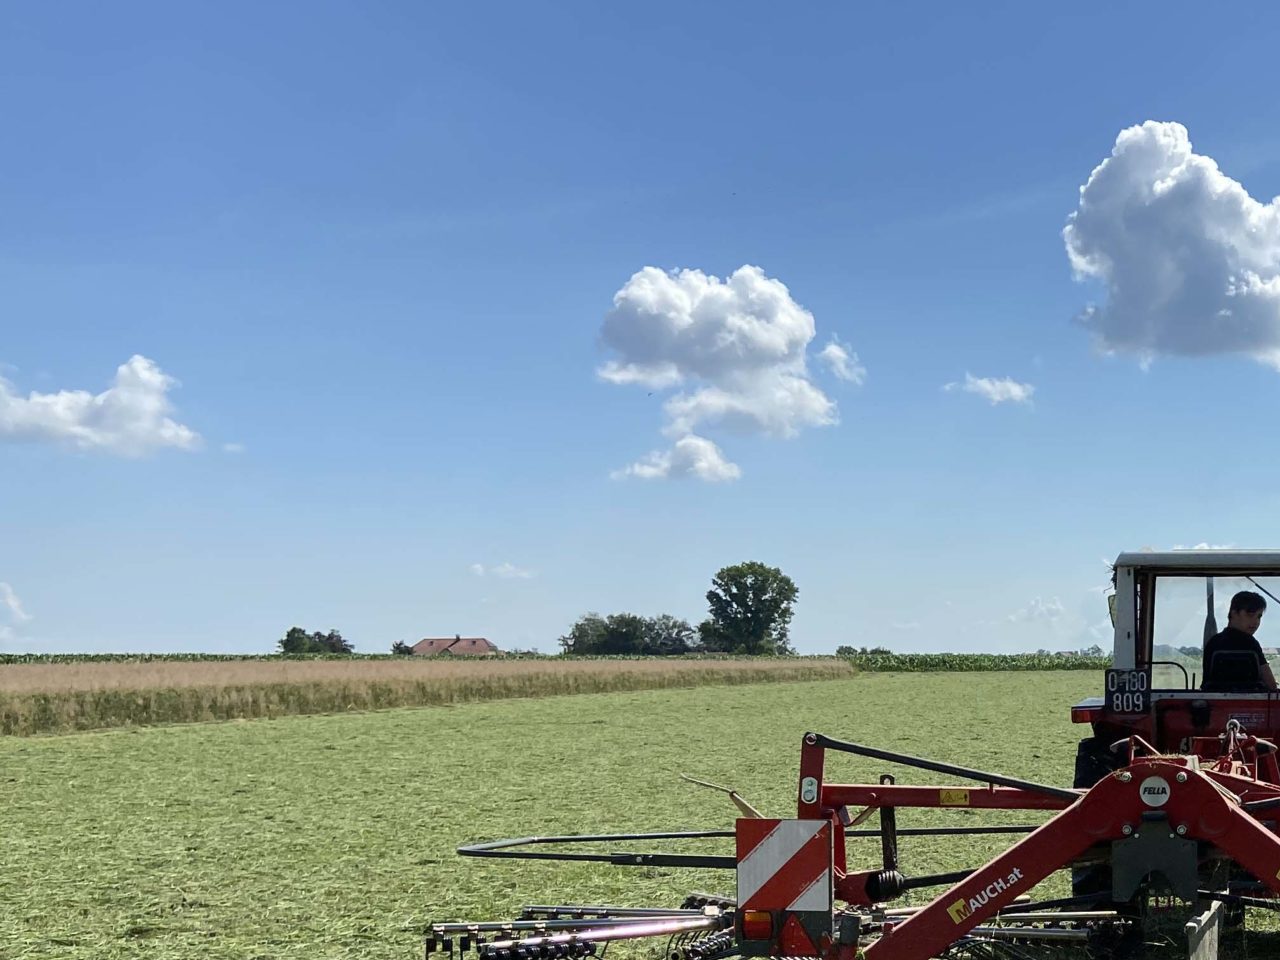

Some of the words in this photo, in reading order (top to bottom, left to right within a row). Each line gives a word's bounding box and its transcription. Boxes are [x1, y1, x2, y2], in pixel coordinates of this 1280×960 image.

[1113, 693, 1143, 711] 809
[1142, 786, 1167, 795] FELLA
[954, 867, 1024, 921] MAUCH.at
